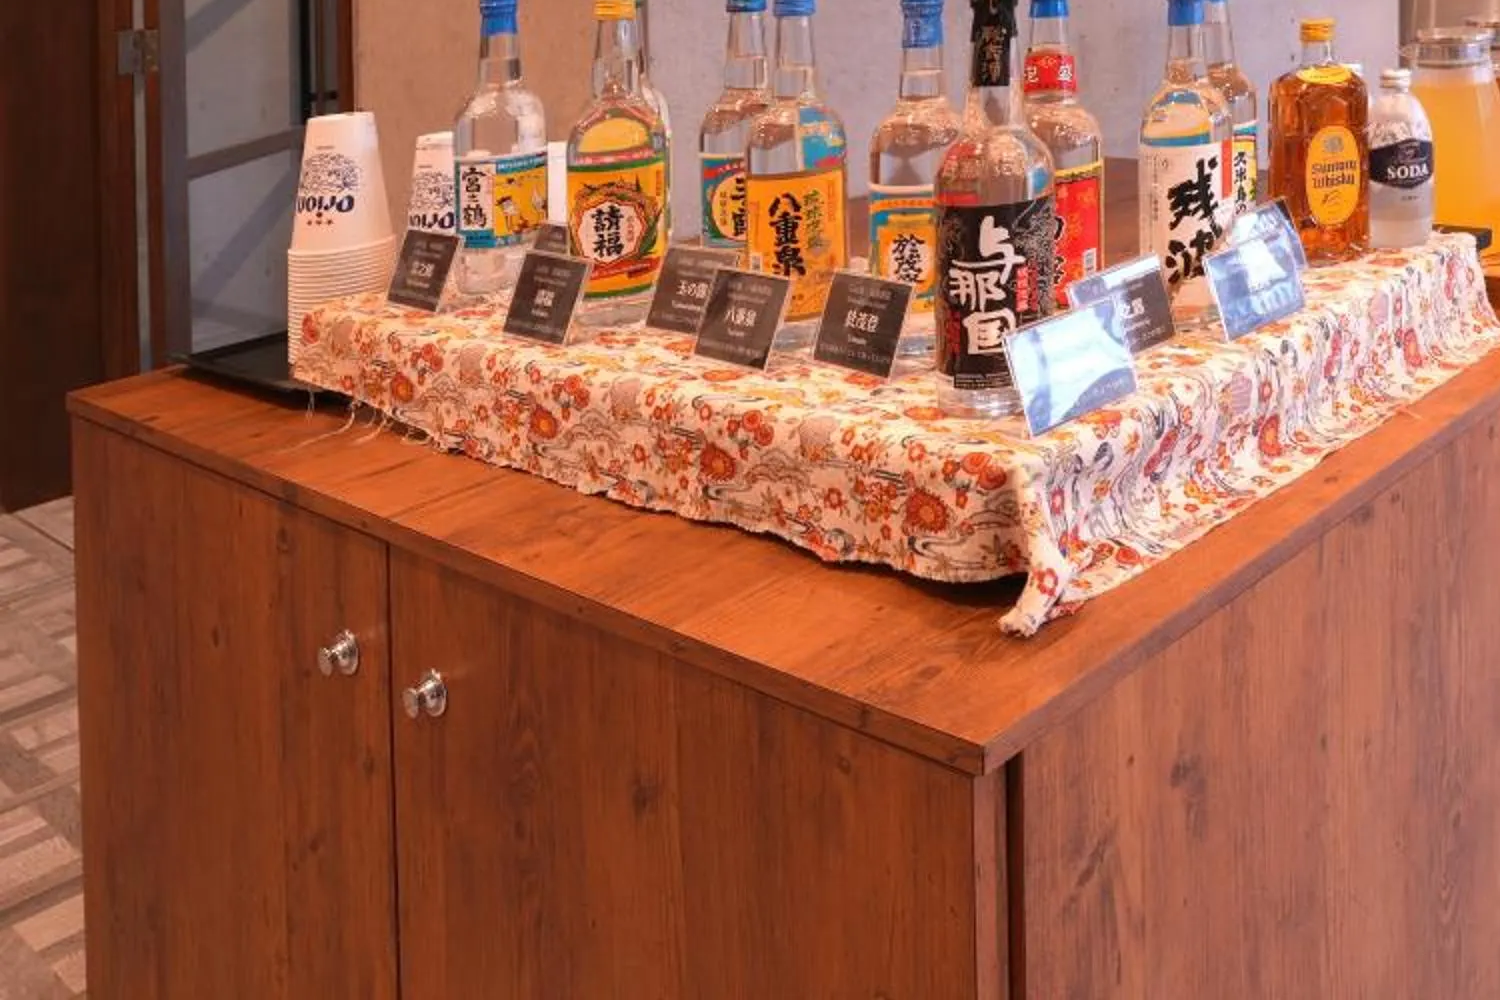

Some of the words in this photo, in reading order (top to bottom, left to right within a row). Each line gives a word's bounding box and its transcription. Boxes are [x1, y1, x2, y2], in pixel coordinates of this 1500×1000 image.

[1233, 151, 1248, 215] 久米島の
[1387, 162, 1430, 179] SODA
[591, 204, 625, 259] 請福
[768, 192, 807, 276] 八重泉
[949, 214, 1027, 356] 与那国
